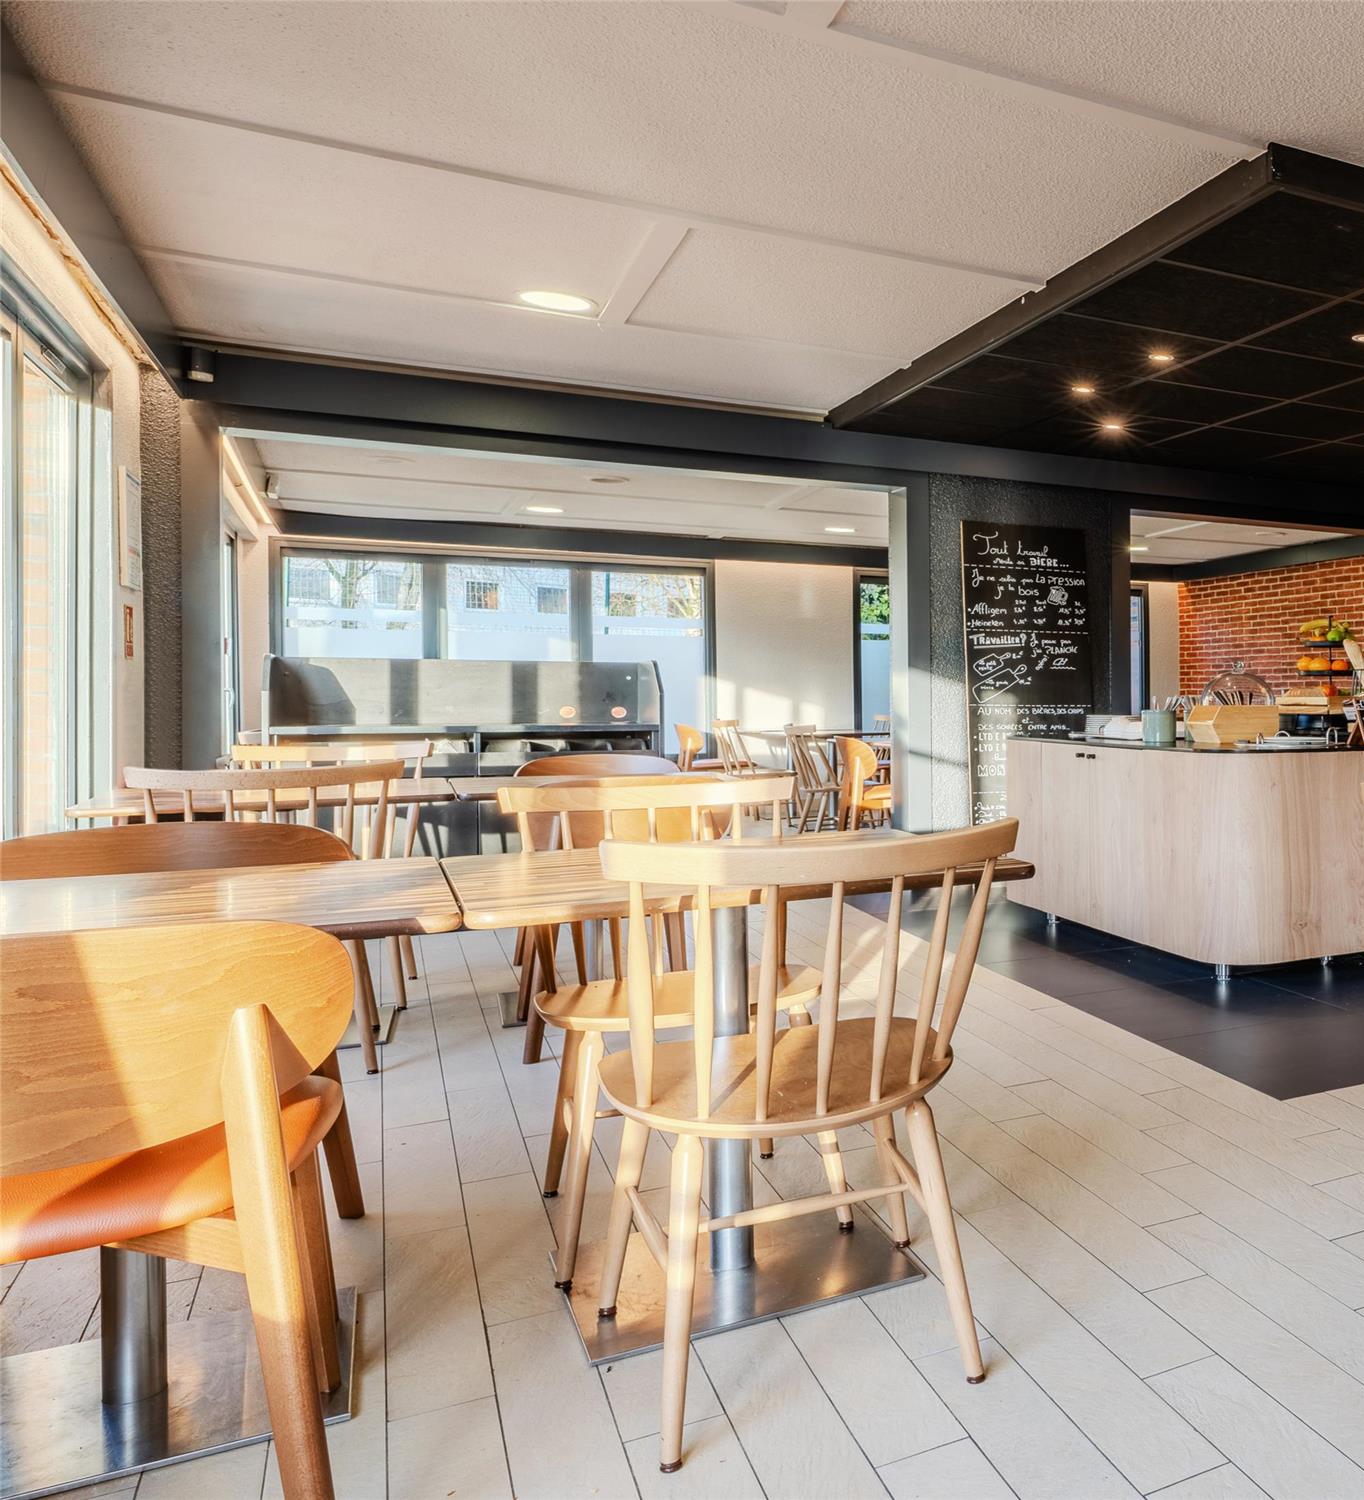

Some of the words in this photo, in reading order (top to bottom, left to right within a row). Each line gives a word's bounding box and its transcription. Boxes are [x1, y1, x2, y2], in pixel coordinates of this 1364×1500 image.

[973, 531, 1008, 555] Tout
[1018, 586, 1040, 596] bois
[970, 618, 1004, 628] Heineken
[977, 707, 991, 716] AU
